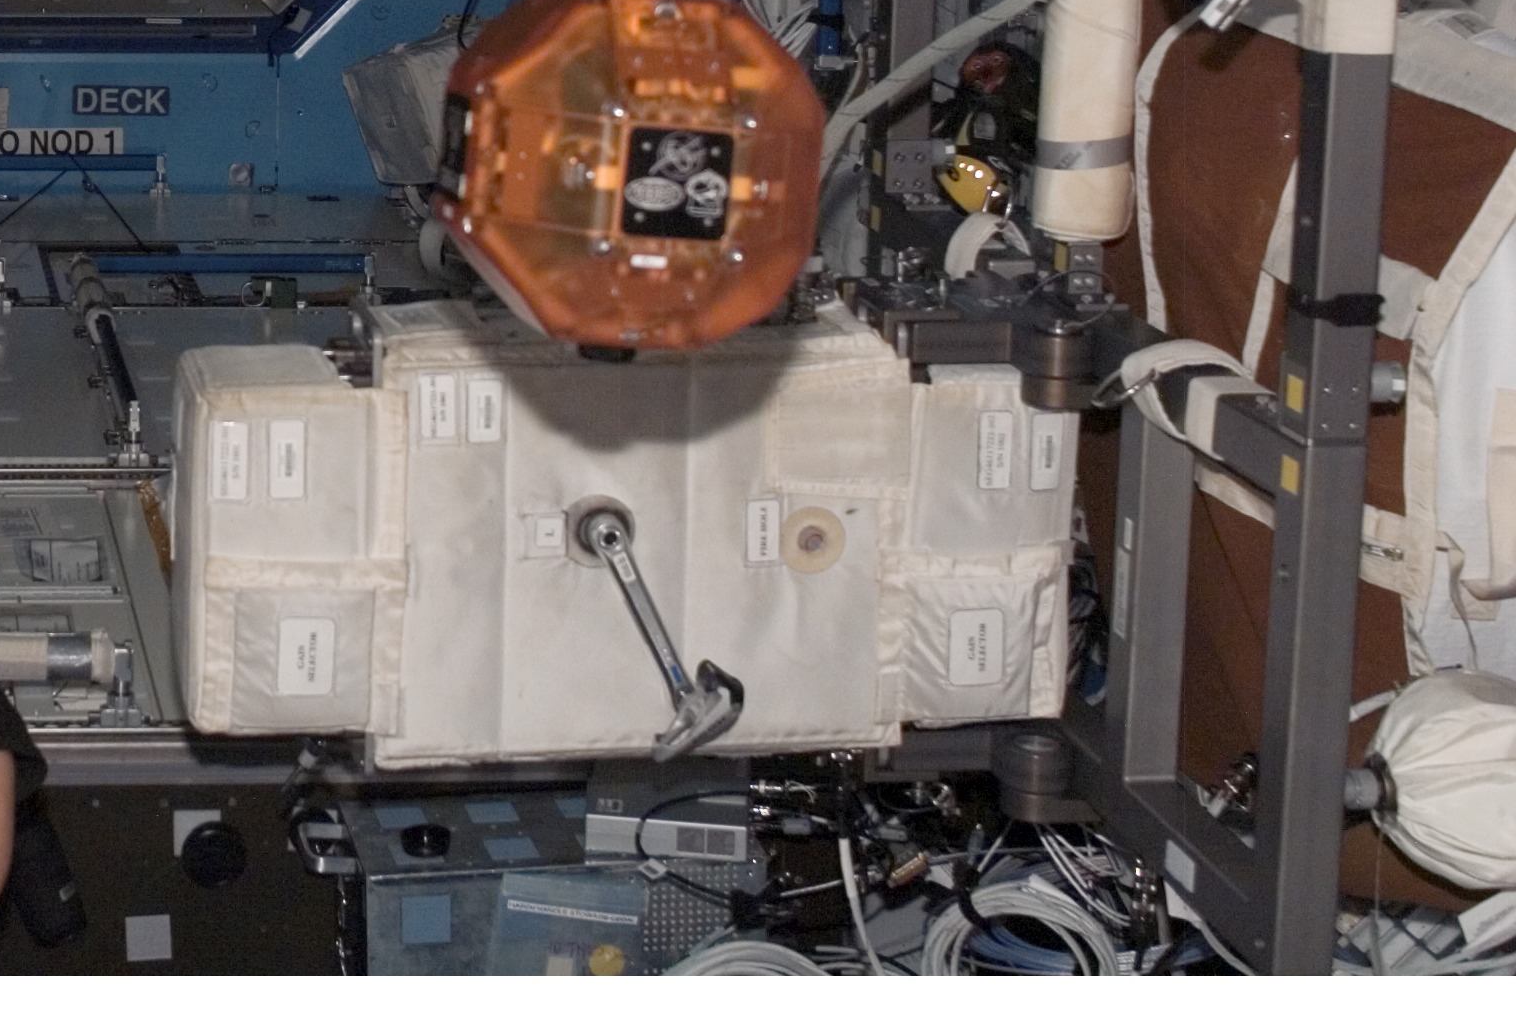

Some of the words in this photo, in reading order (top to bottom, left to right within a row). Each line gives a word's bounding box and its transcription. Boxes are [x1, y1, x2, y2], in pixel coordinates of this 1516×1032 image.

[76, 87, 168, 114] DECK
[30, 130, 94, 155] NOD
[104, 130, 116, 155] 1
[307, 631, 317, 682] SELECTOR
[978, 623, 987, 672] SELECTOR
